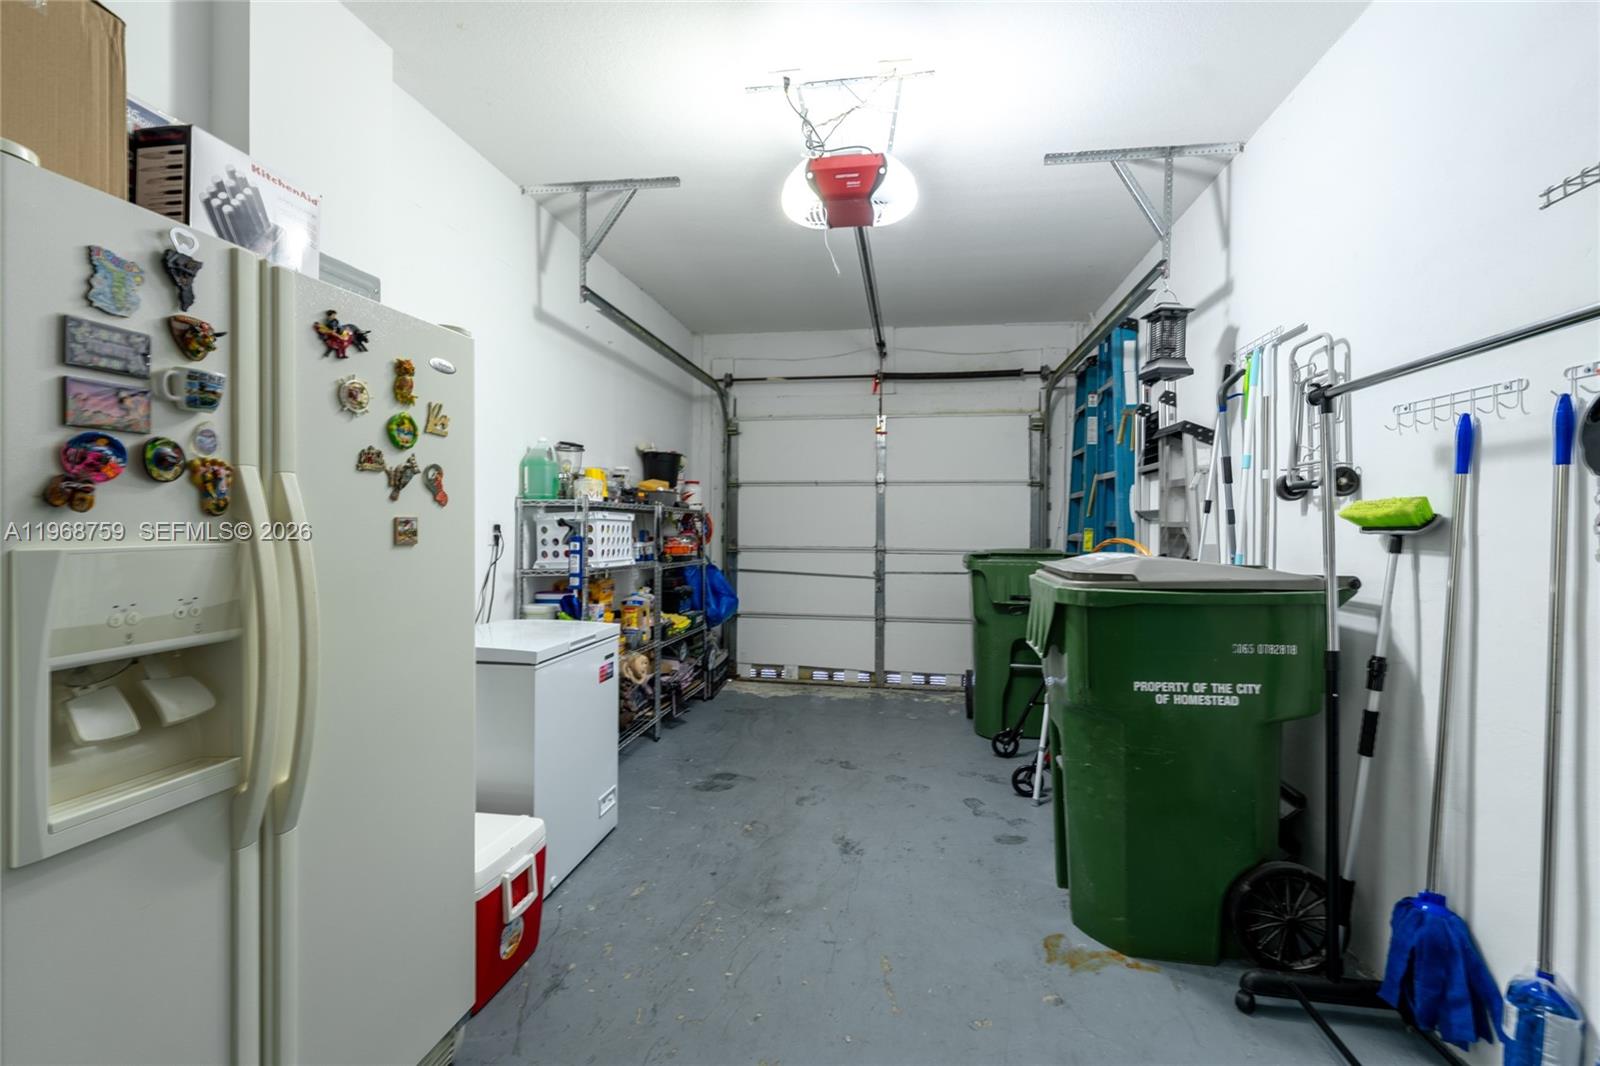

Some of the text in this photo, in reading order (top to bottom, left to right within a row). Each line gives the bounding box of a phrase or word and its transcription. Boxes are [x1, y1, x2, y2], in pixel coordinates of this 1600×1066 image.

[251, 163, 319, 206] KitchenAid
[1133, 681, 1262, 695] PROPERTY OF THE CITY
[1155, 693, 1240, 707] OF HOMESTEAD
